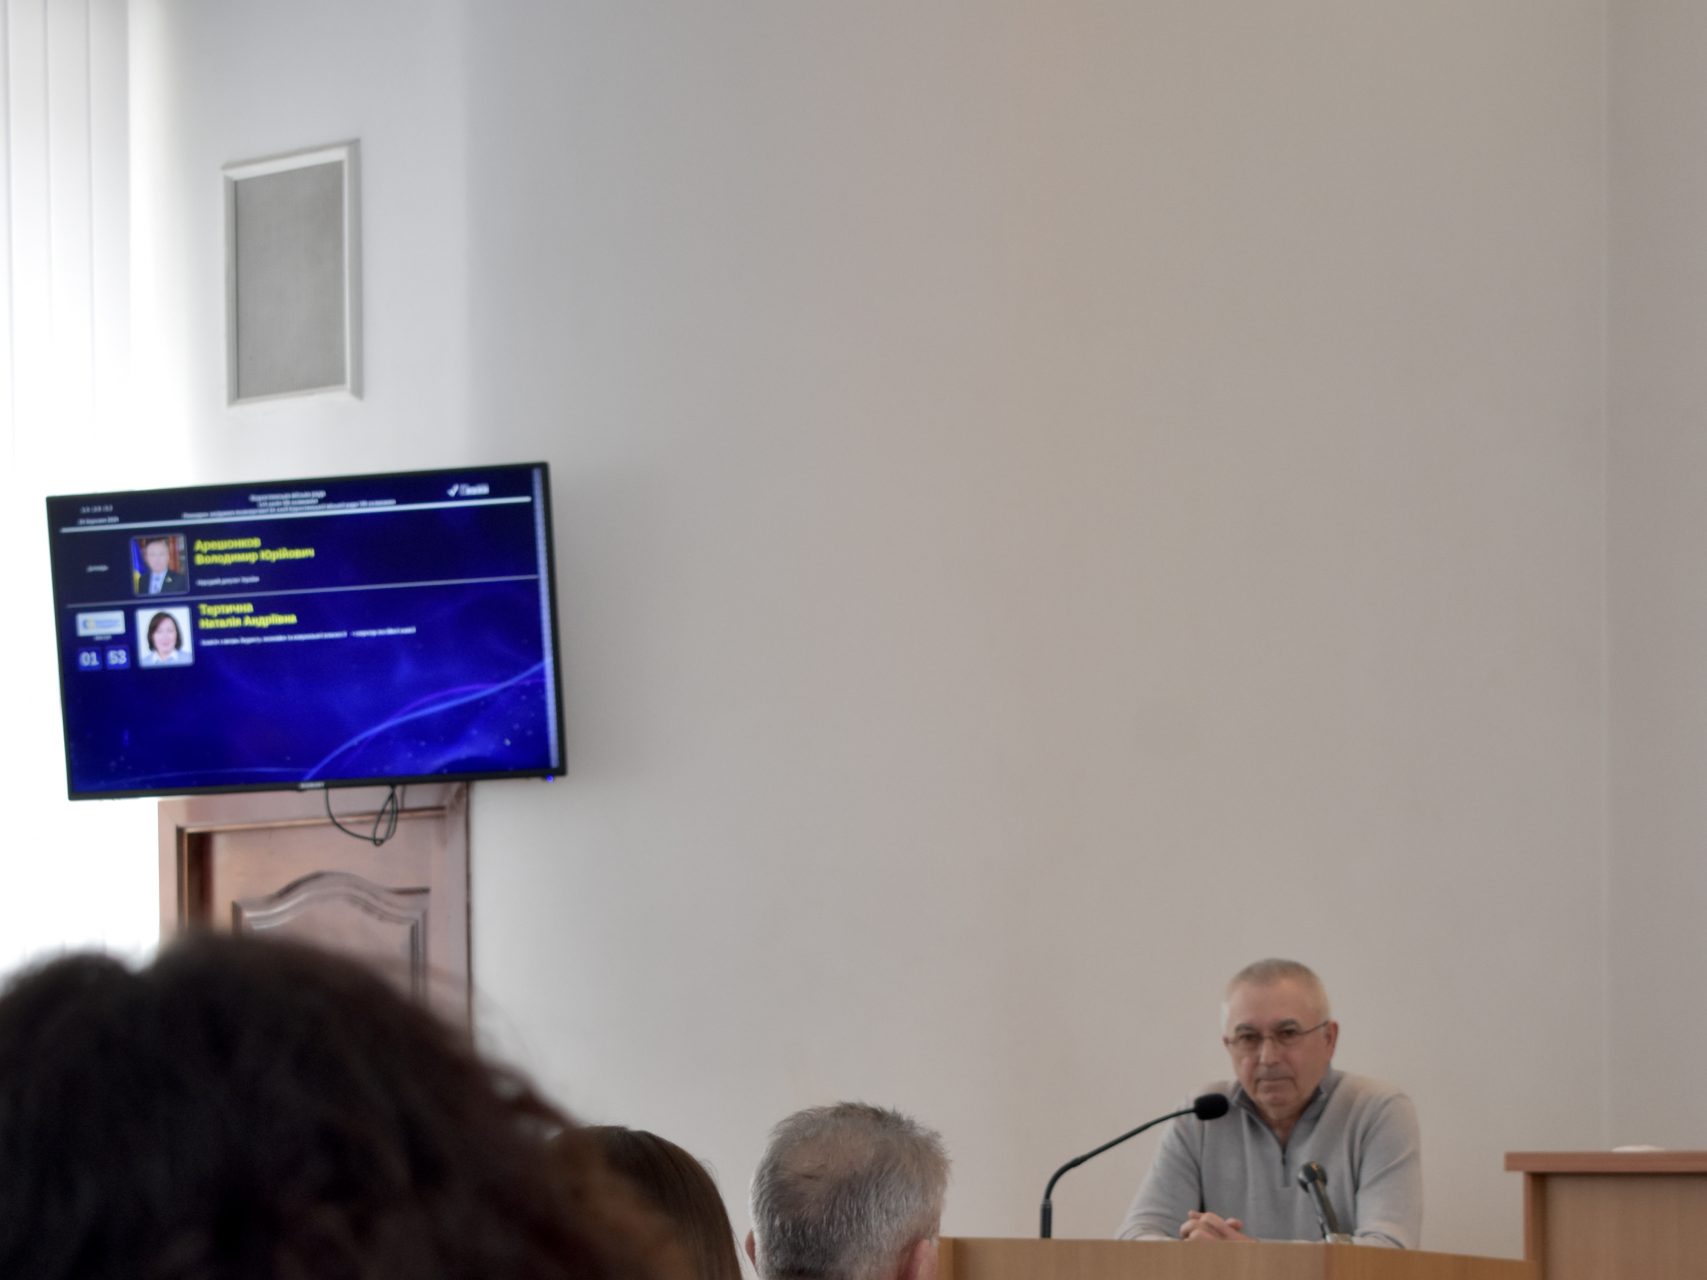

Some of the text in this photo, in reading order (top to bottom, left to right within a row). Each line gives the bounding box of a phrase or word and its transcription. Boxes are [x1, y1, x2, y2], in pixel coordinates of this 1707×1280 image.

[194, 547, 315, 566] Володимир Юрійович
[199, 613, 298, 629] Наталія Андріївна
[79, 651, 99, 666] 01
[107, 649, 127, 665] 53
